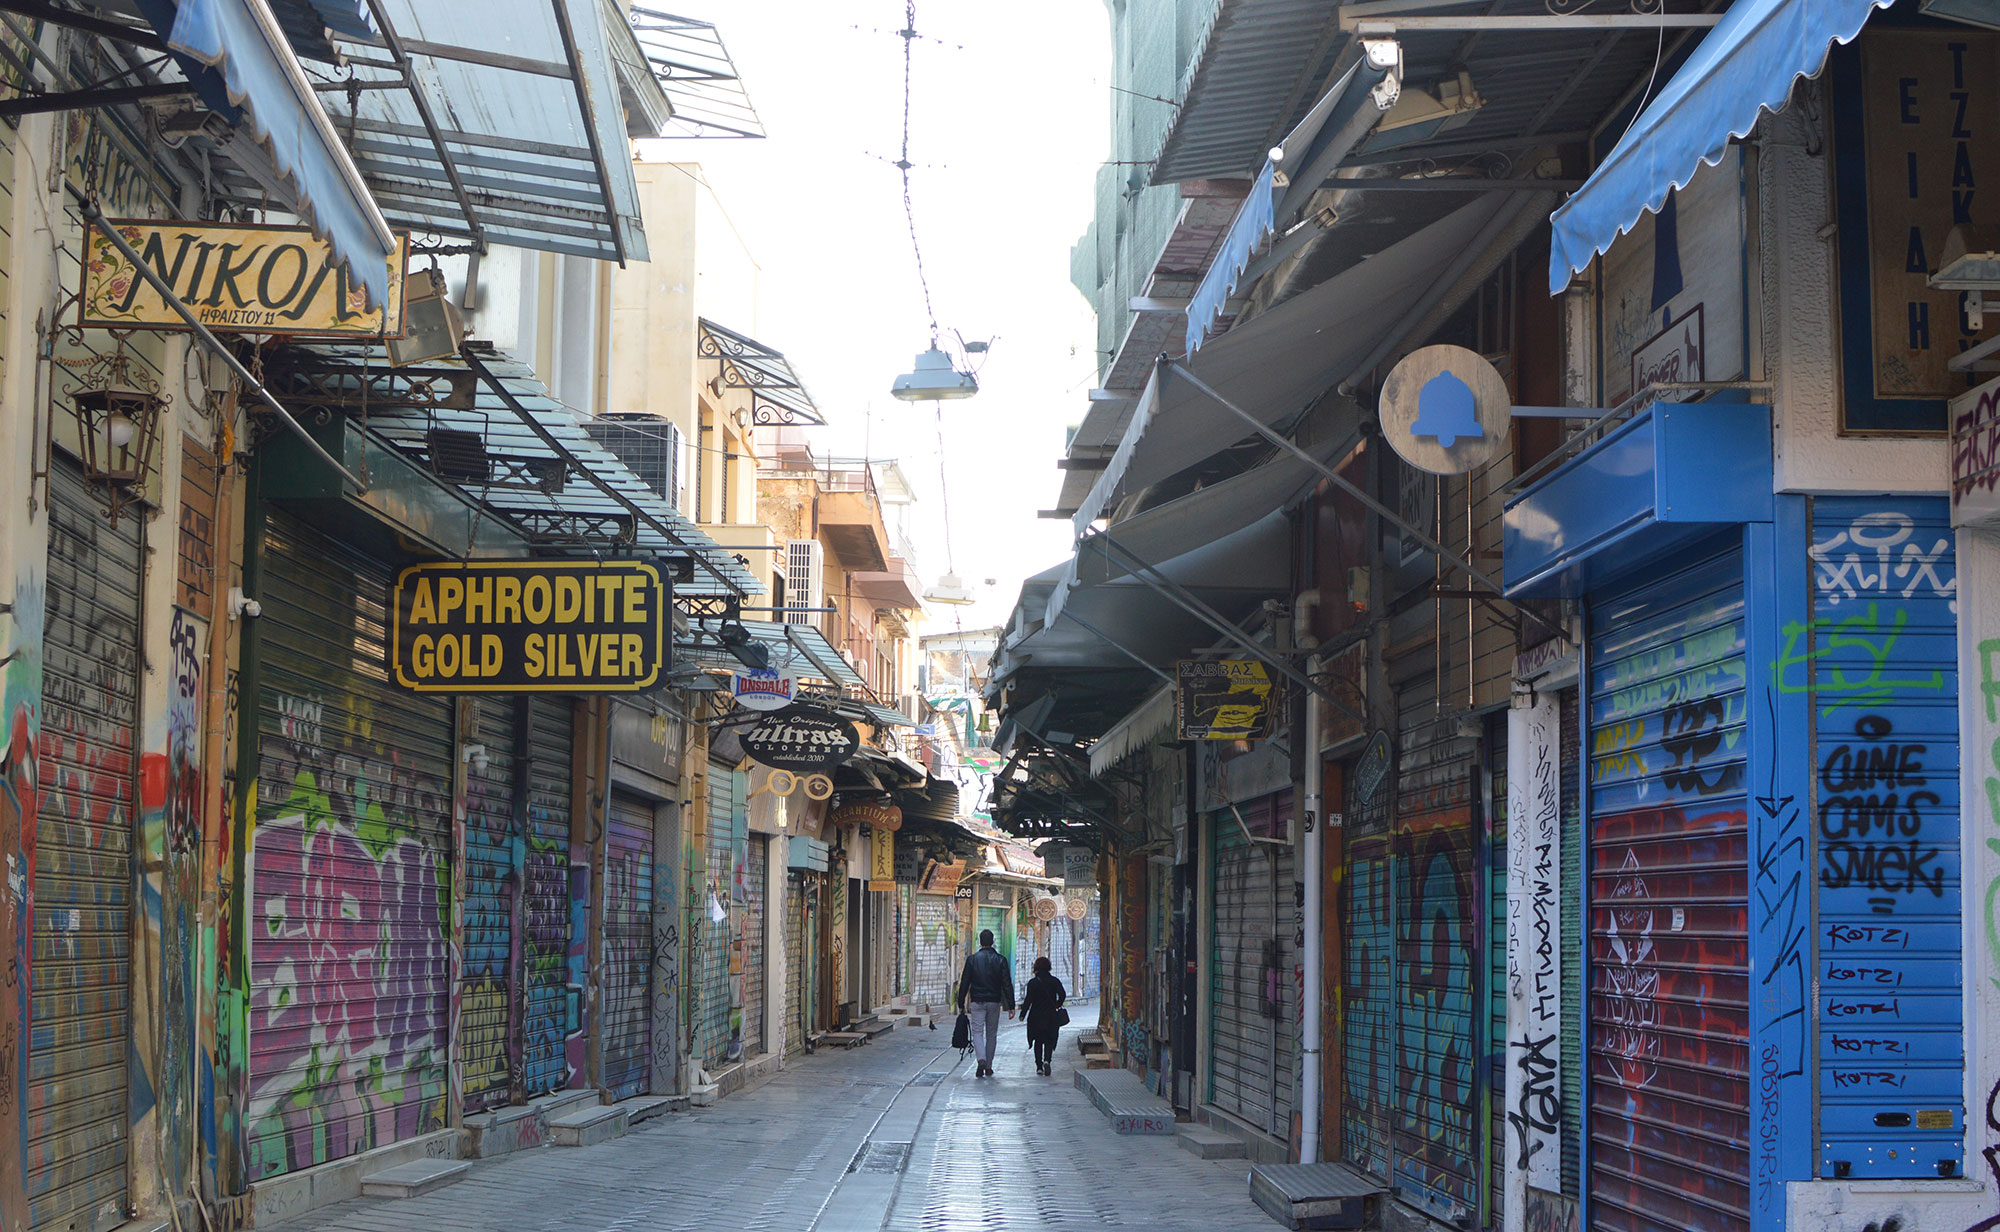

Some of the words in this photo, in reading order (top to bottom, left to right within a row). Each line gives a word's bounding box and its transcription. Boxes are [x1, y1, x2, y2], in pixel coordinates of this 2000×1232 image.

[409, 575, 648, 624] APHRODITE
[412, 634, 503, 678] GOLD
[524, 633, 644, 678] SILVER
[1181, 662, 1254, 677] ΣΑΒΒΑΣ
[735, 674, 792, 700] LONSDALE
[763, 716, 784, 724] The
[790, 715, 838, 728] Original
[747, 724, 851, 746] ultras
[753, 744, 845, 753] CLOTHES
[772, 753, 806, 762] established
[807, 754, 825, 762] 2010
[955, 887, 972, 897] Lee
